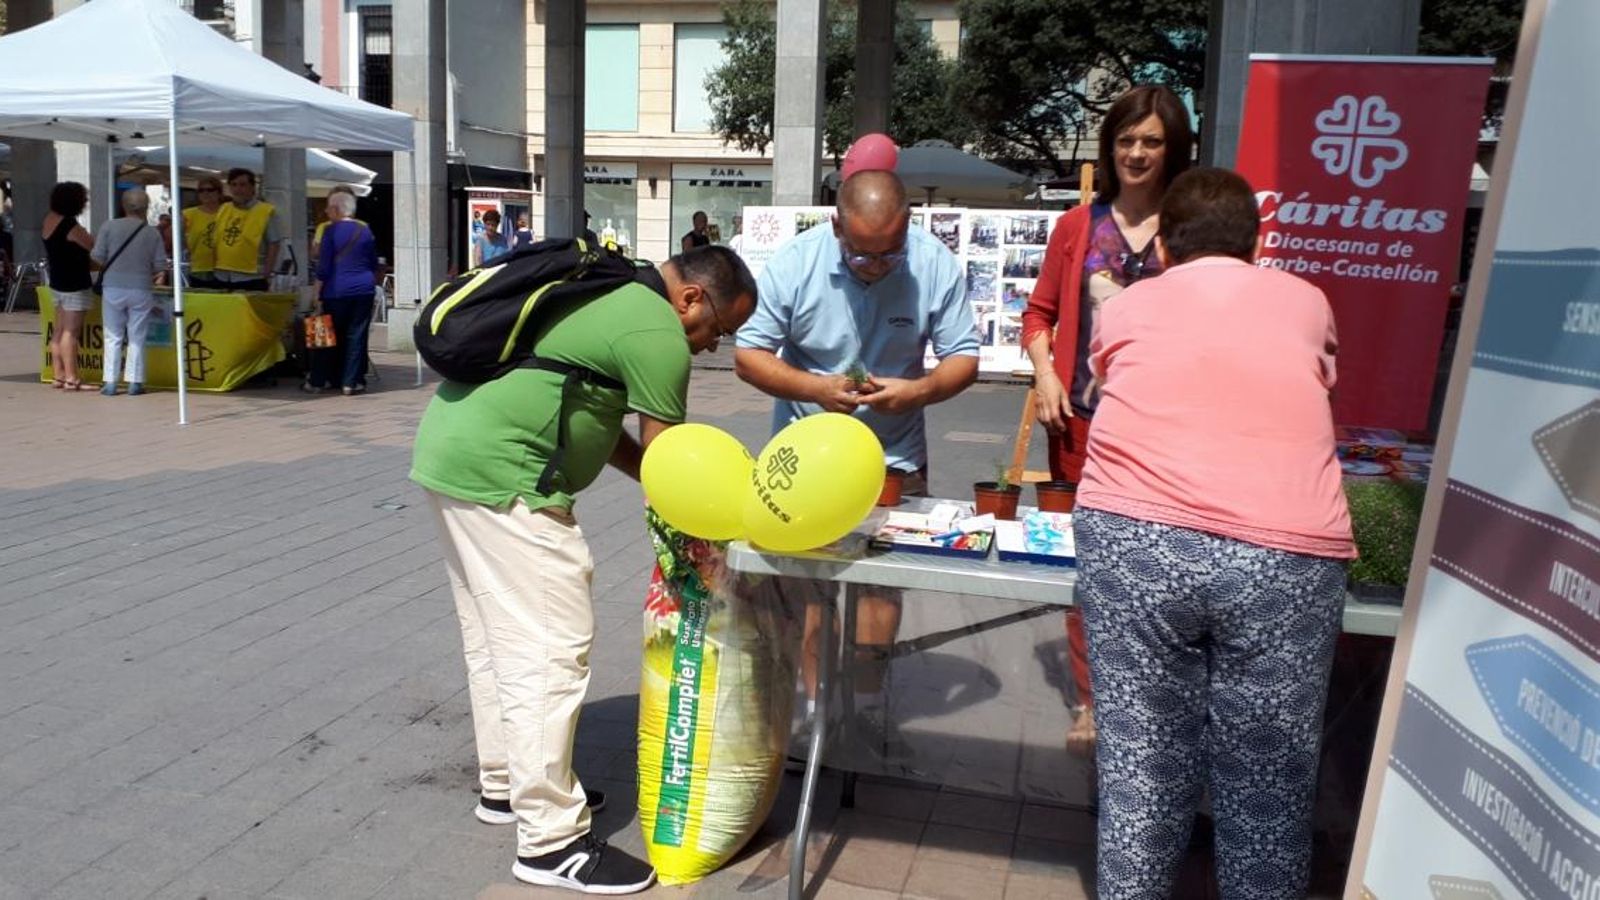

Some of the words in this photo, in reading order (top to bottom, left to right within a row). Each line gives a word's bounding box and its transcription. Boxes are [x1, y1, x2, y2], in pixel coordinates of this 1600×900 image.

[585, 165, 608, 174] ARA
[710, 167, 744, 177] ZARA
[1254, 191, 1447, 233] Cáritas
[1264, 231, 1379, 255] Diocesana
[1386, 241, 1414, 258] de
[1256, 256, 1440, 284] gorbe-Castellón
[752, 467, 791, 524] áritas
[665, 656, 700, 786] FertilComplet
[1461, 766, 1544, 864] INVESTIGACIÓ
